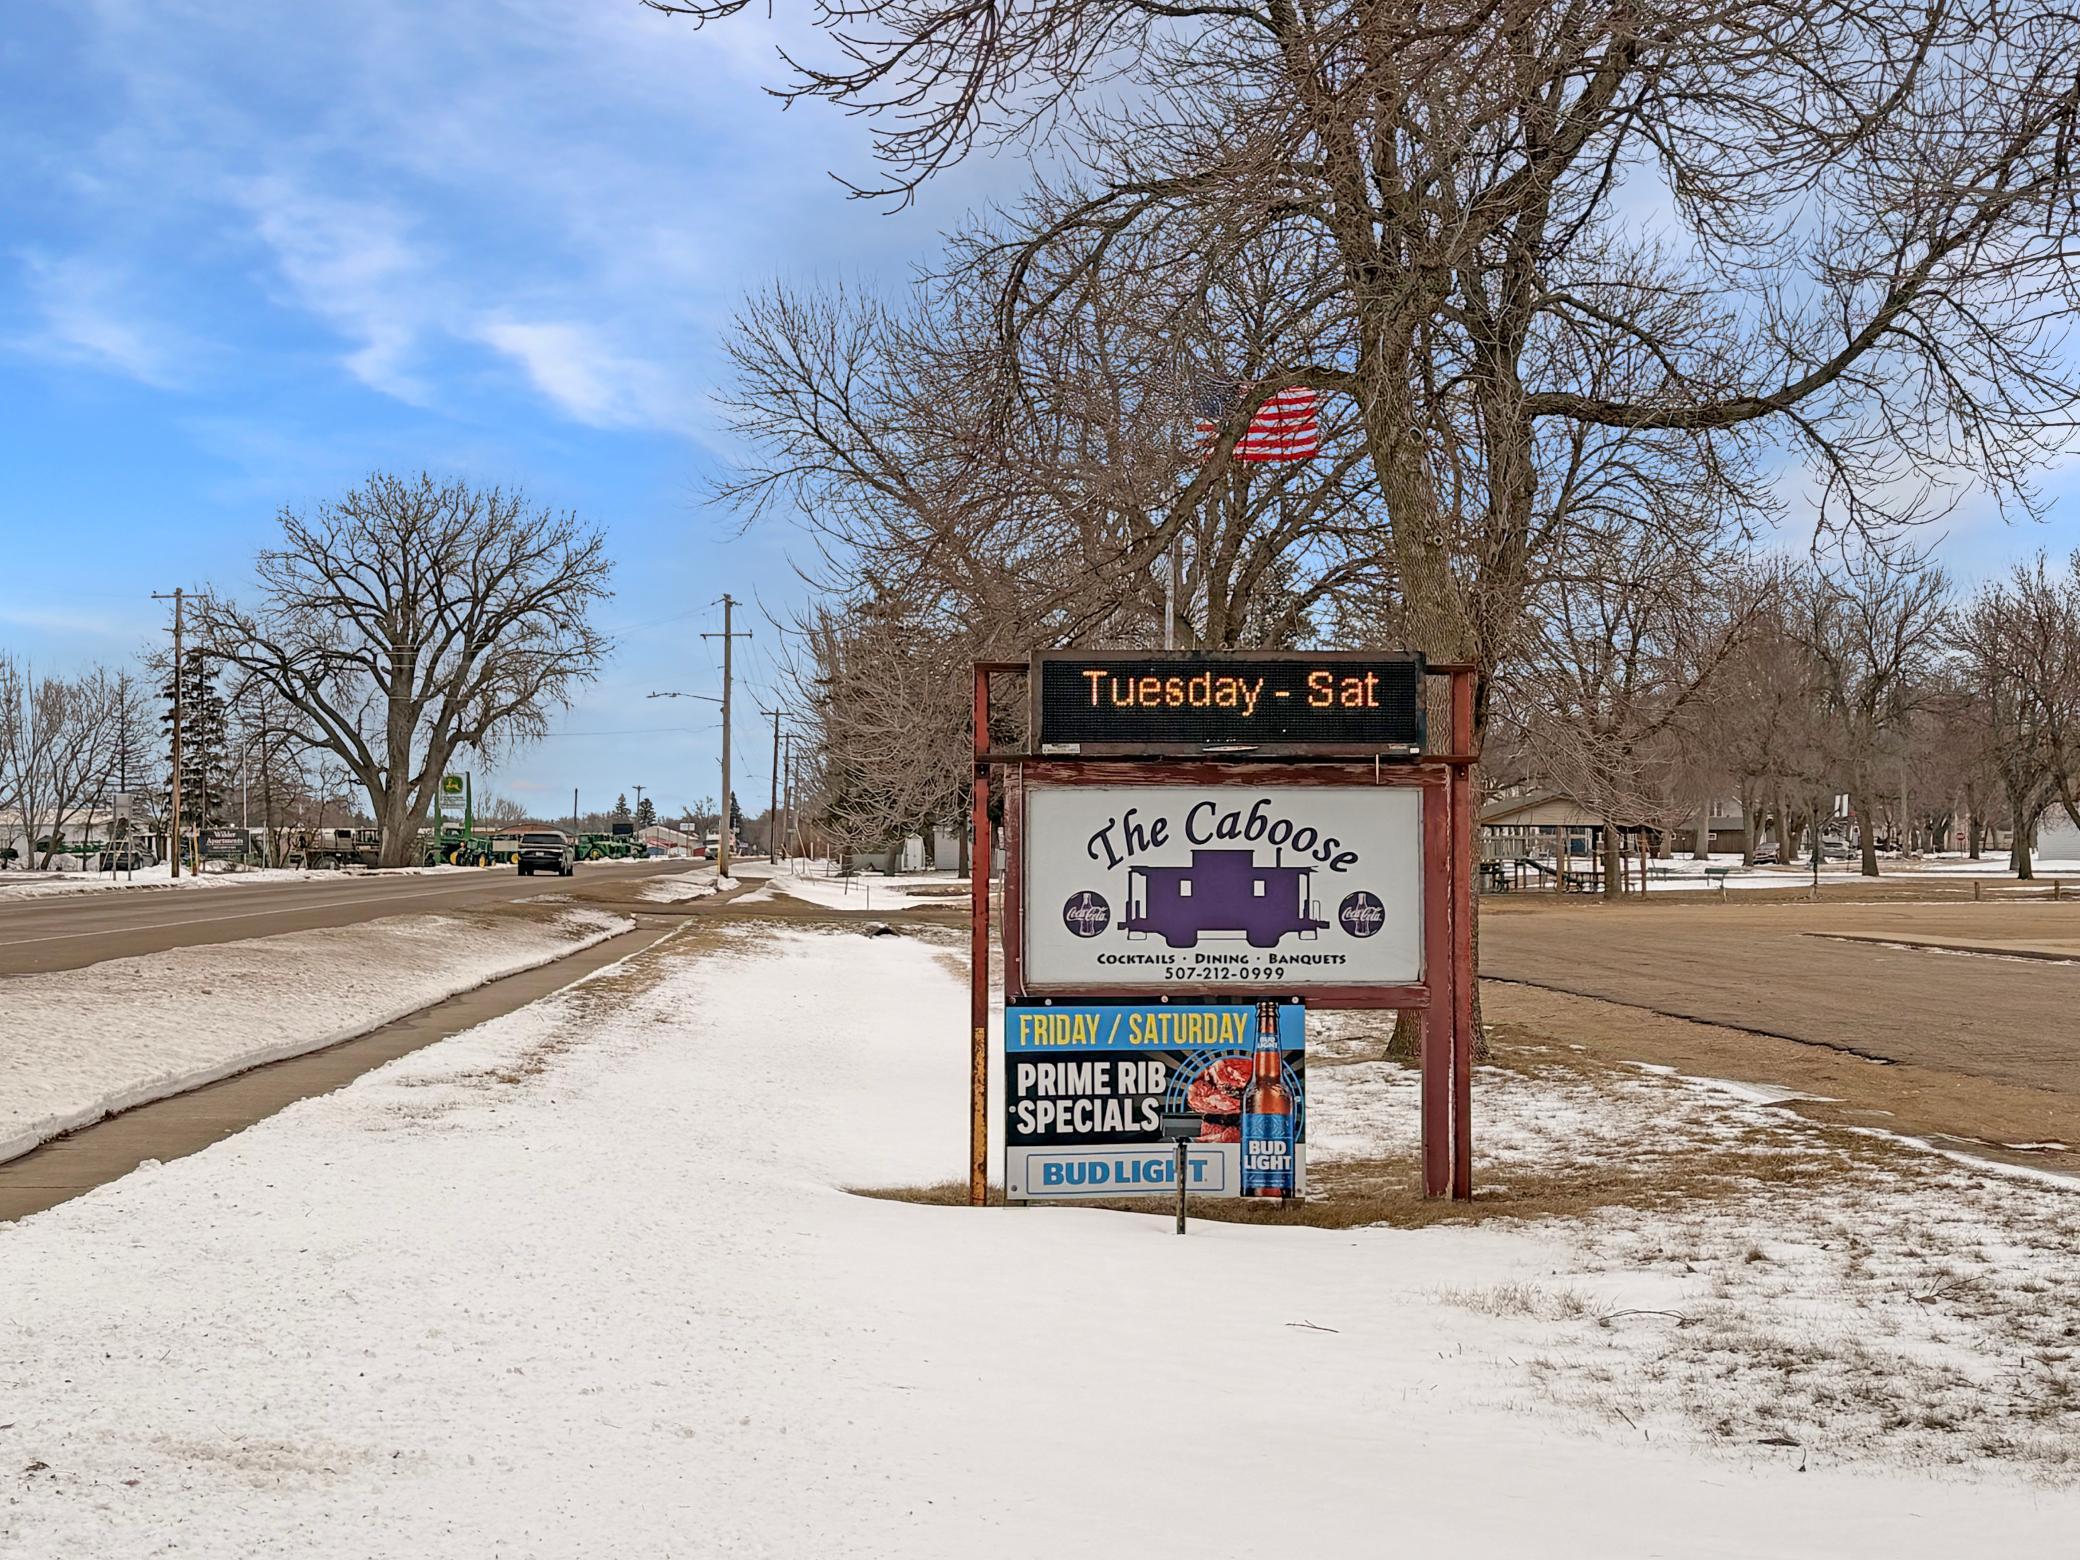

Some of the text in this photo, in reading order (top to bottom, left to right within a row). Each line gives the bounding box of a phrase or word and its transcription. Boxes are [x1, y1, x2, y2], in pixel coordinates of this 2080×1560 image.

[1082, 670, 1263, 716] Tuesday
[1307, 670, 1379, 707] Sat
[206, 838, 244, 846] Apartments
[213, 830, 236, 838] Wilder
[1087, 798, 1359, 873] The Caboose
[1097, 953, 1175, 965] COCKTAILS
[1195, 953, 1249, 965] DINING
[1269, 953, 1346, 965] BANQUETS
[1165, 967, 1285, 980] 507-212-0999
[1019, 1013, 1100, 1046] FRIDAY
[1129, 1012, 1248, 1045] SATURDAY
[1017, 1061, 1167, 1097] PRIME RIB
[1016, 1097, 1160, 1135] SPECIALS
[1248, 1140, 1287, 1155] BUD
[1244, 1155, 1292, 1170] LIGHT
[1043, 1161, 1110, 1186] BUD
